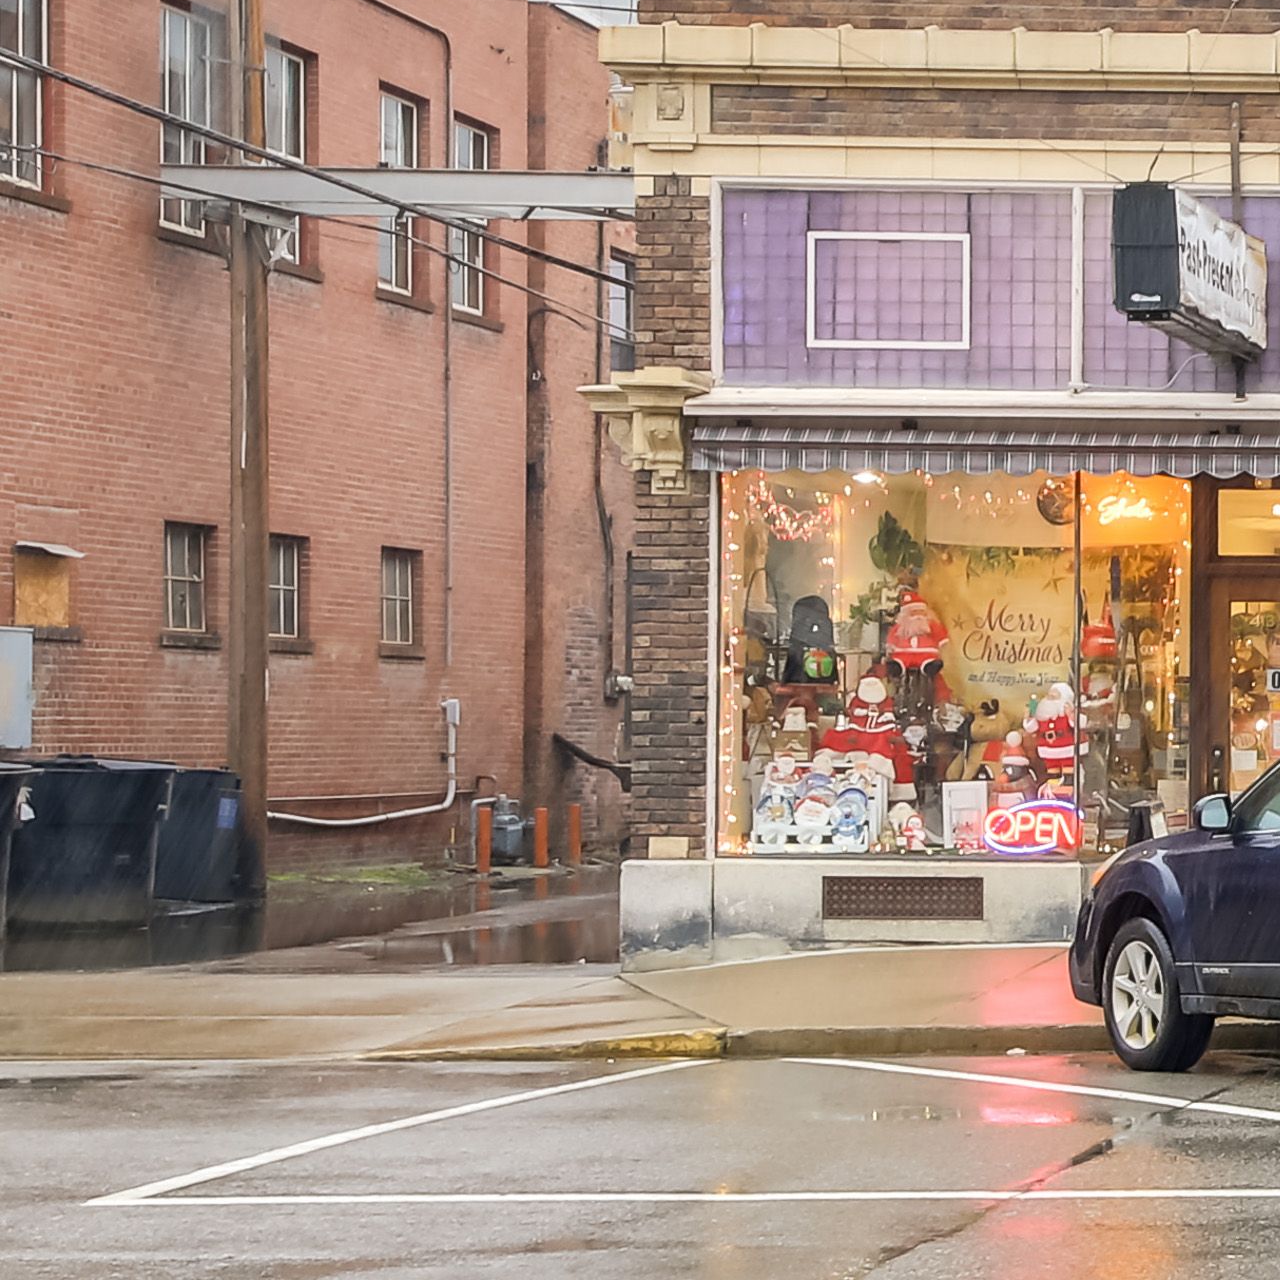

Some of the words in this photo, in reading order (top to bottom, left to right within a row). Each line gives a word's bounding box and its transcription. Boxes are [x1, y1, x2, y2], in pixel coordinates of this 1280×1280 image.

[975, 599, 1051, 644] Merry
[962, 630, 1063, 664] Christmas
[984, 809, 1076, 846] OPEN
